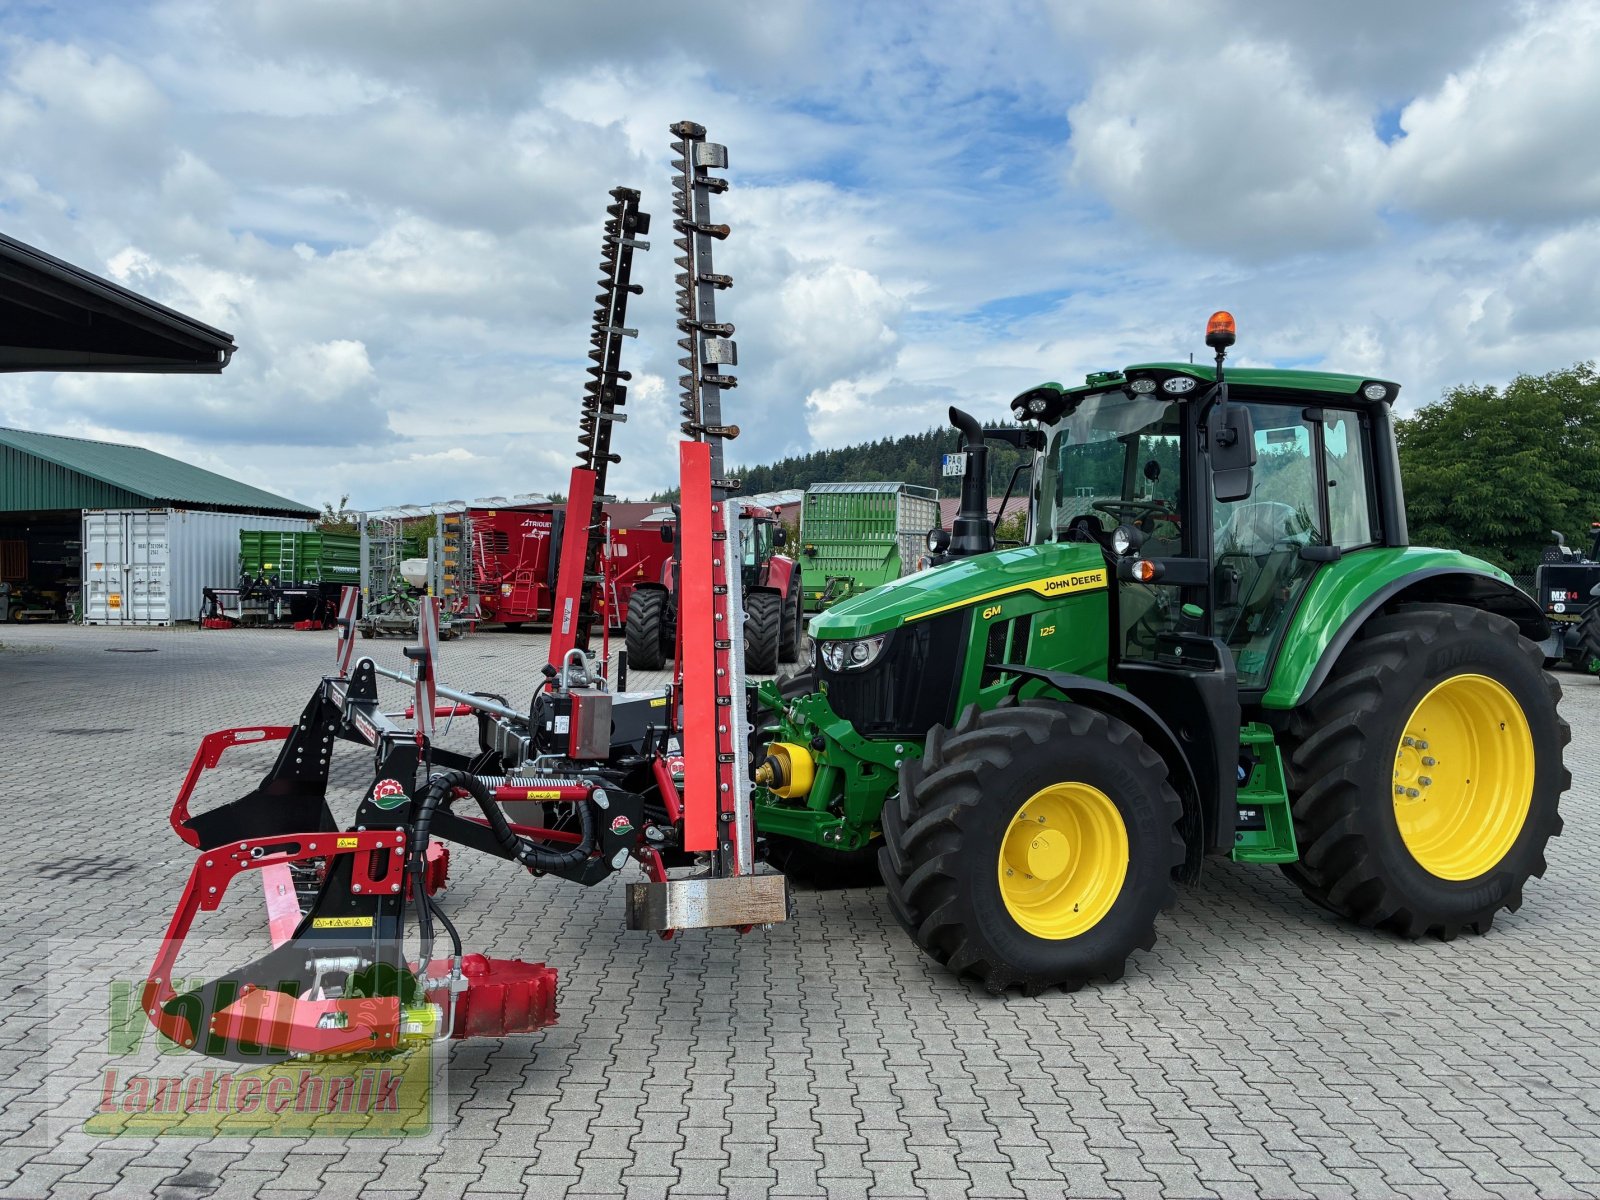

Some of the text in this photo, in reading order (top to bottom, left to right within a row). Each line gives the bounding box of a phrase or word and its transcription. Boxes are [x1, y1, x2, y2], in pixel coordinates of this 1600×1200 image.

[1044, 574, 1102, 591] JOHN DEERE
[982, 605, 1002, 620] 6M
[1040, 625, 1056, 637] 125
